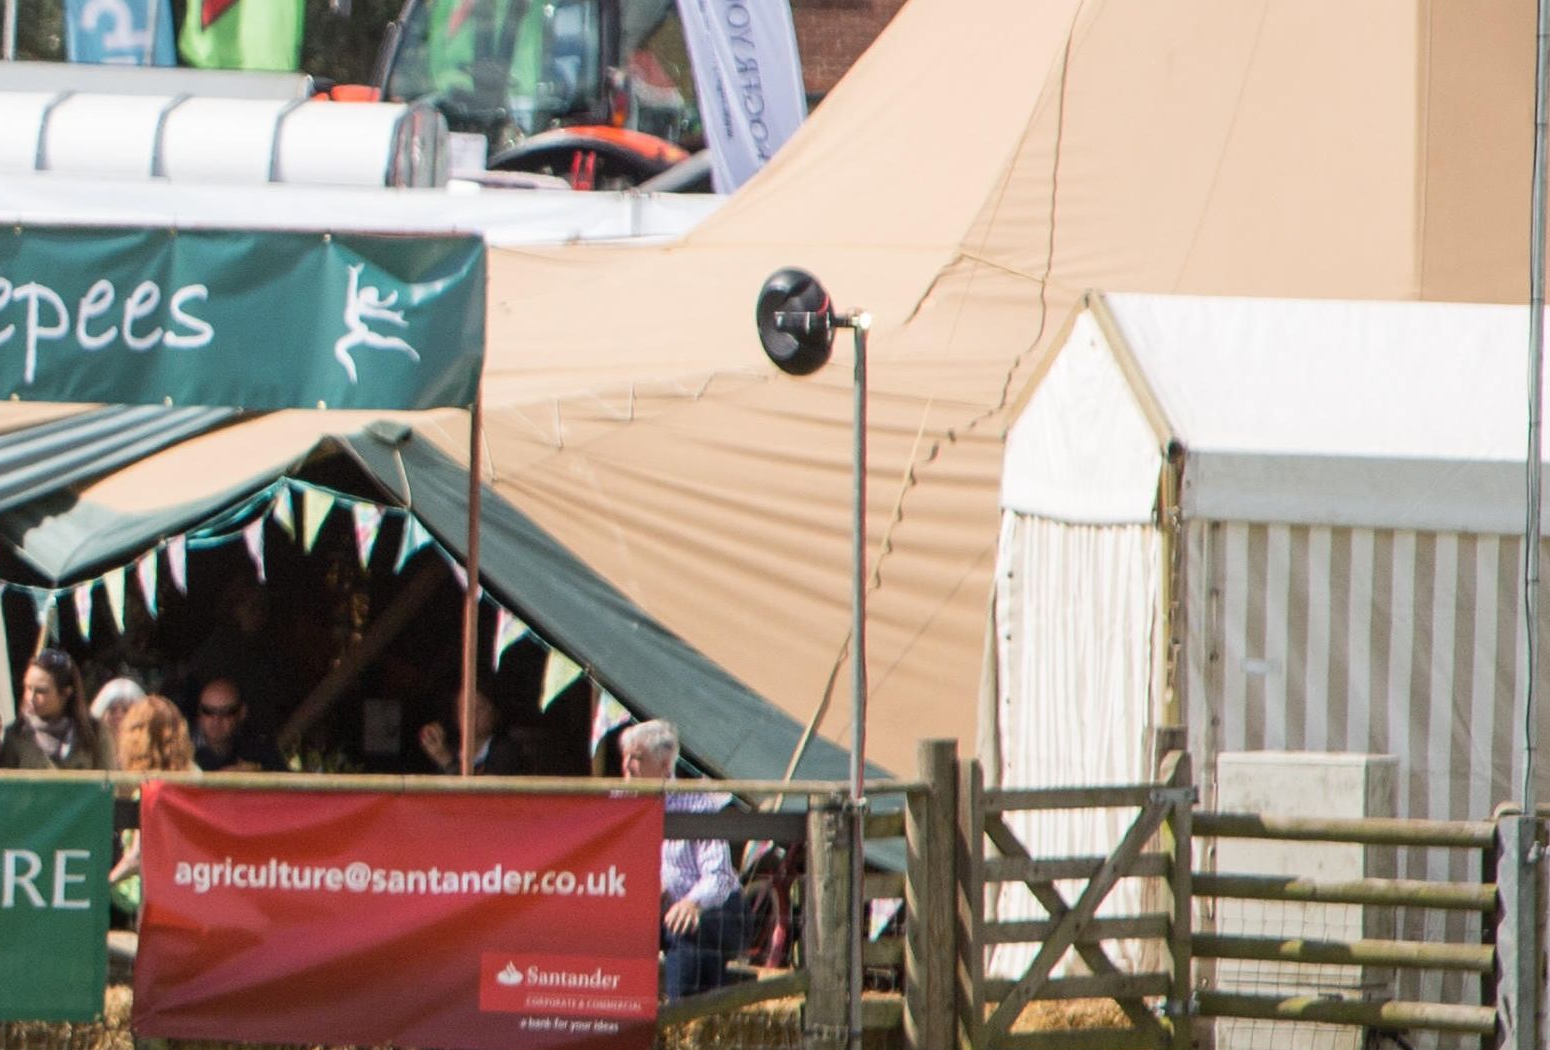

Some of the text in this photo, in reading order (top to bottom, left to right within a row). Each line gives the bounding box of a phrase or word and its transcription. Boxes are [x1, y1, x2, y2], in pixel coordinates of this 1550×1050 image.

[174, 856, 628, 898] agriculture@santander.co.uk
[526, 963, 622, 990] Santander
[554, 1017, 568, 1031] for
